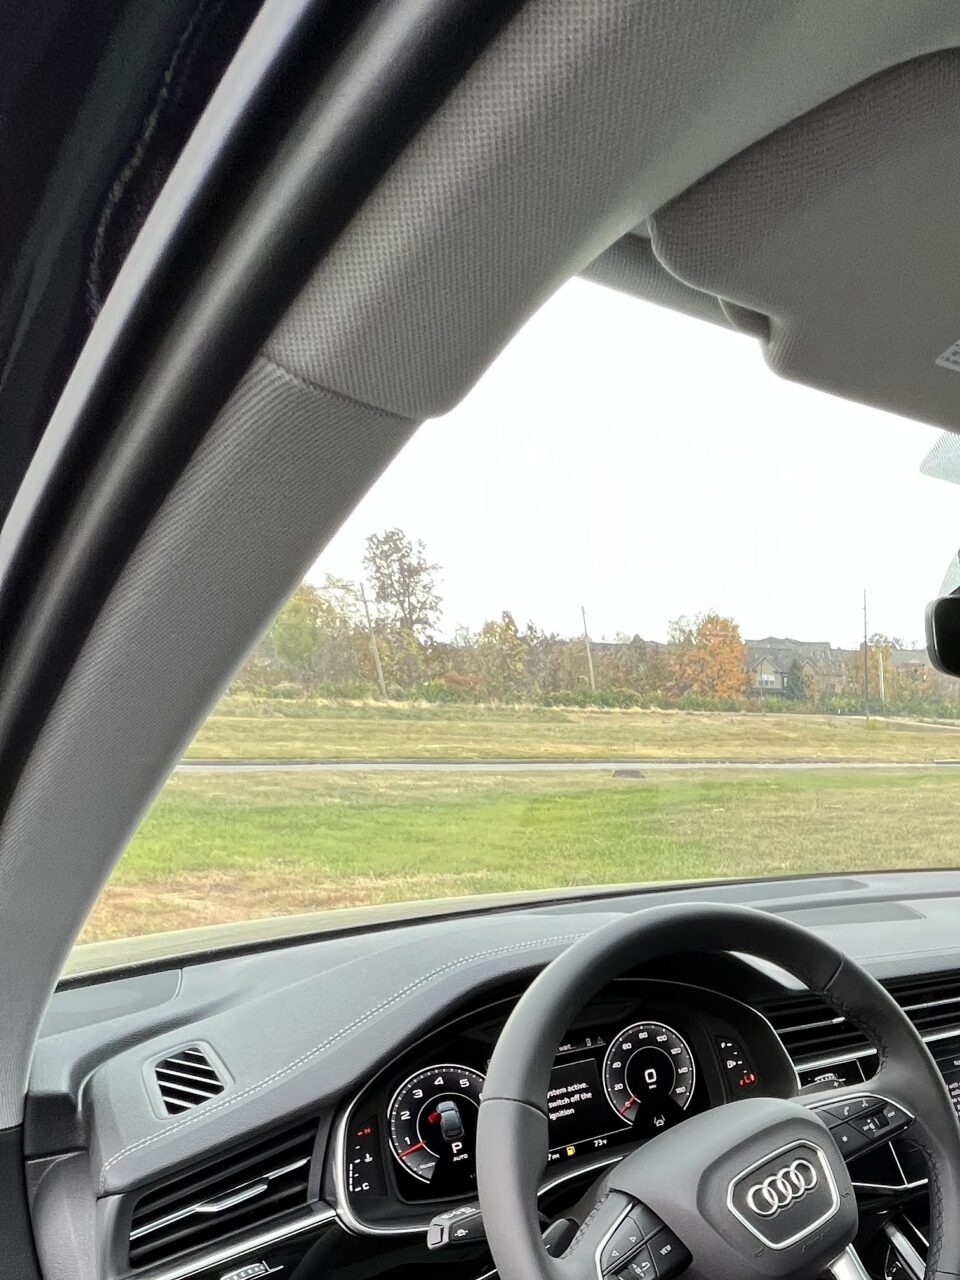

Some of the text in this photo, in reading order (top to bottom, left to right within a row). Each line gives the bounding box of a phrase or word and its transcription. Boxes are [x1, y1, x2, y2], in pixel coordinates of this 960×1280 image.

[644, 1069, 656, 1083] 0
[434, 1077, 444, 1086] 4
[459, 1078, 470, 1088] 5
[412, 1089, 423, 1098] 3
[400, 1111, 411, 1120] 2
[404, 1136, 411, 1145] 1
[451, 1142, 462, 1153] P
[362, 1182, 370, 1190] C
